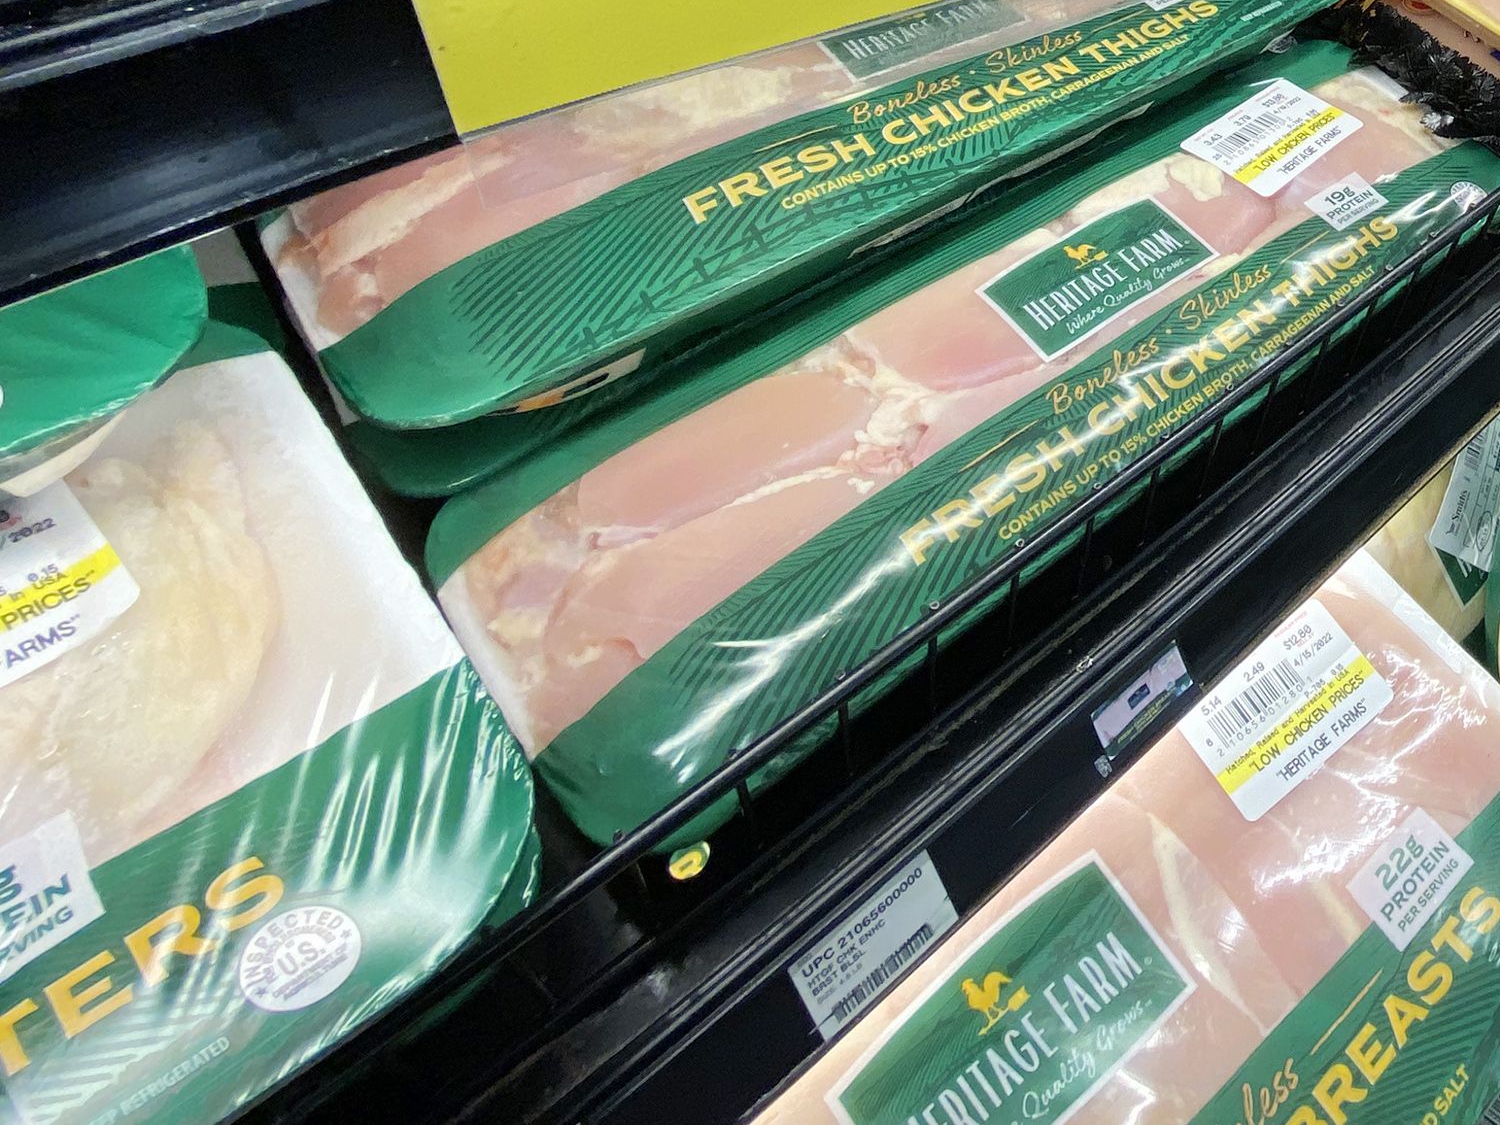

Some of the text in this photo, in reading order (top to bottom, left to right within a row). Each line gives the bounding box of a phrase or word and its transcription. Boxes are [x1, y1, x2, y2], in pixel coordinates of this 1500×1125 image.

[842, 18, 929, 62] HERITAGE
[846, 29, 1083, 125] Boneless Skinless
[682, 0, 1219, 225] FRESH CHICKEN THIGHS
[780, 33, 1191, 211] CONTAINS UP TO 15% CHICKEN BROTH, CARRAGEENAN AND SALT
[1203, 133, 1223, 148] 3.43
[1276, 130, 1311, 157] CHICKEN
[1323, 185, 1357, 206] 19g
[1325, 188, 1374, 221] PROTEIN
[1336, 197, 1380, 225] PER SERVING
[1022, 228, 1185, 332] HERITAGE FARM
[1065, 257, 1187, 335] Where Quality Grows
[1045, 263, 1272, 416] Boneless Skinless
[899, 214, 1398, 567] FRESH CHICKEN THIGHS
[997, 266, 1376, 542] CONTAINS UP TO 15% CHICKEN BROTH, CARRAGEENAN AND SALT
[1243, 661, 1266, 683] 2.49
[1282, 624, 1313, 652] $12.80
[1293, 632, 1335, 668] 4/15/2022
[1201, 695, 1223, 717] 5.14
[1248, 669, 1365, 773] "LOW CHICKEN PRICES"
[1275, 696, 1368, 782] "HERITAGE FARMS"
[1374, 833, 1426, 892] 22g
[1379, 839, 1450, 923] PROTEIN
[1396, 855, 1461, 933] PER SERVING
[243, 908, 346, 991] INSPECTED
[276, 940, 328, 977] U.S.
[801, 866, 923, 979] UPC 21065600000
[811, 971, 838, 998] BRST
[1042, 930, 1145, 1035] FARM
[120, 1035, 231, 1117] REFRIGERATED
[1020, 1002, 1148, 1120] Quality Grows
[1435, 1063, 1471, 1111] SALT
